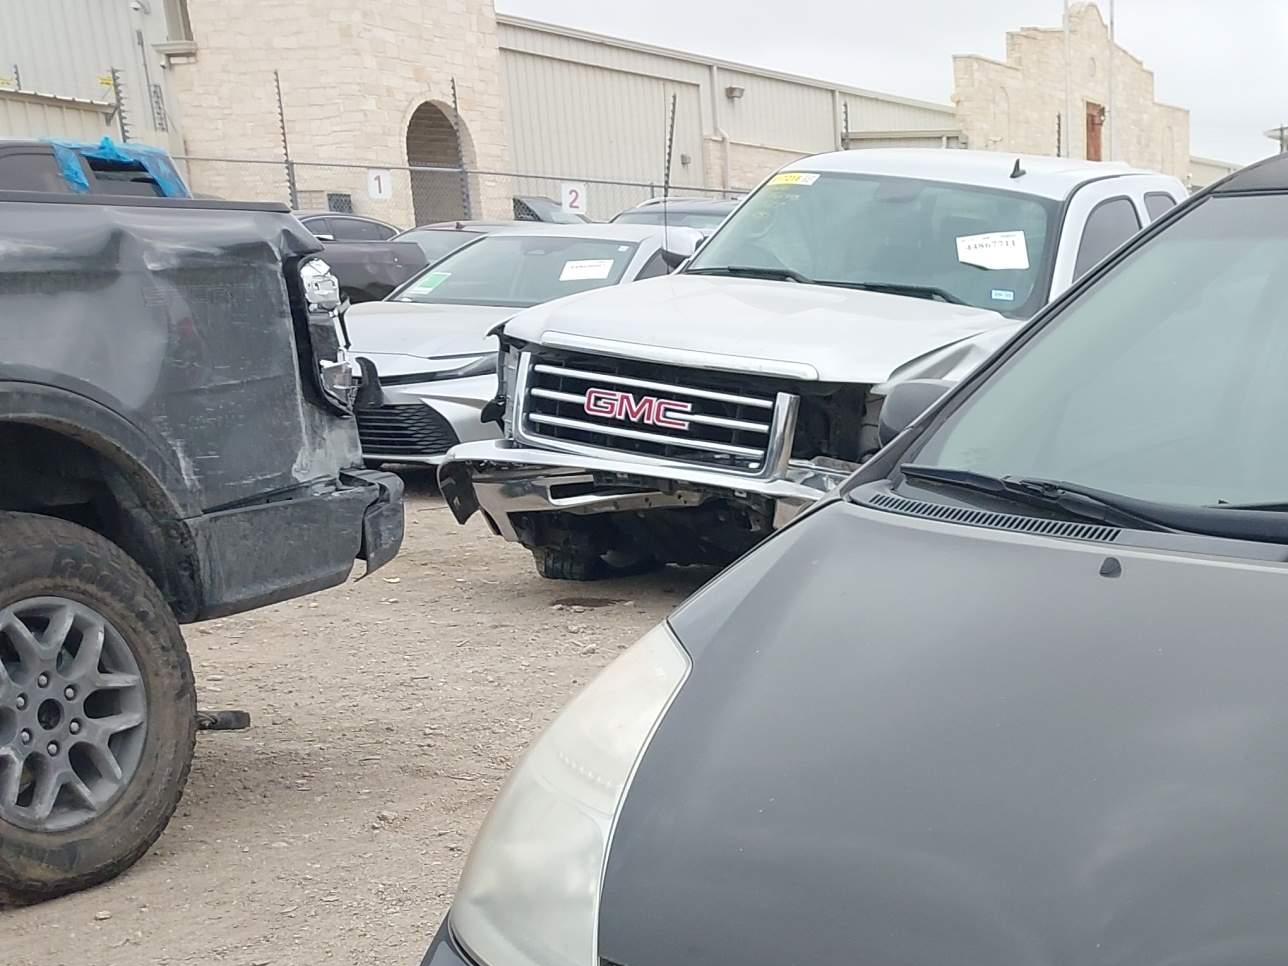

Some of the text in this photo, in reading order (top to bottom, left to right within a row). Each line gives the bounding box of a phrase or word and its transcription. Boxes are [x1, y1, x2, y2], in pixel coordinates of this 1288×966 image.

[373, 174, 384, 195] 1
[568, 188, 581, 209] 2
[583, 387, 693, 431] GMC
